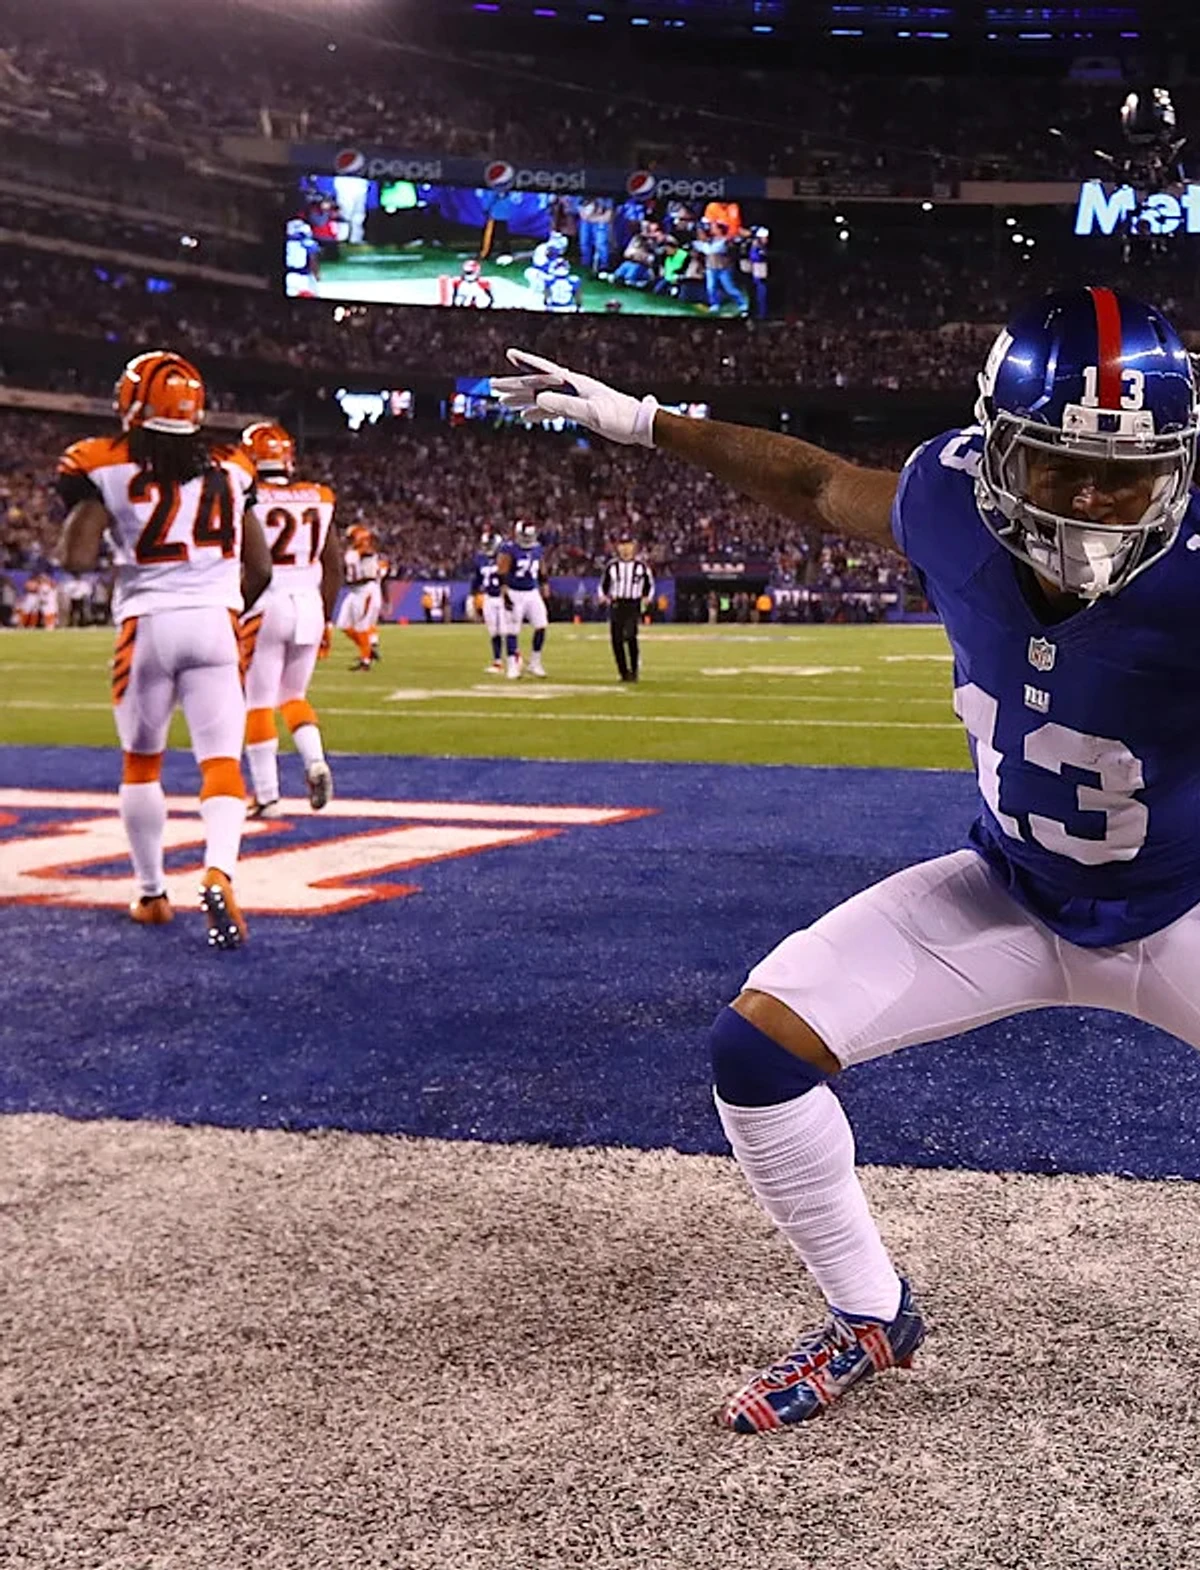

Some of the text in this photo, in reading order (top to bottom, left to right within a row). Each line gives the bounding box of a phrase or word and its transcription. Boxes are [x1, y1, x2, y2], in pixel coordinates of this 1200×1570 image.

[368, 158, 442, 180] pepsi
[515, 169, 586, 191] pepsi
[655, 176, 725, 199] pepsi
[1080, 366, 1145, 411] 13
[128, 465, 236, 565] 24
[266, 507, 320, 565] 21
[953, 682, 1149, 866] 13
